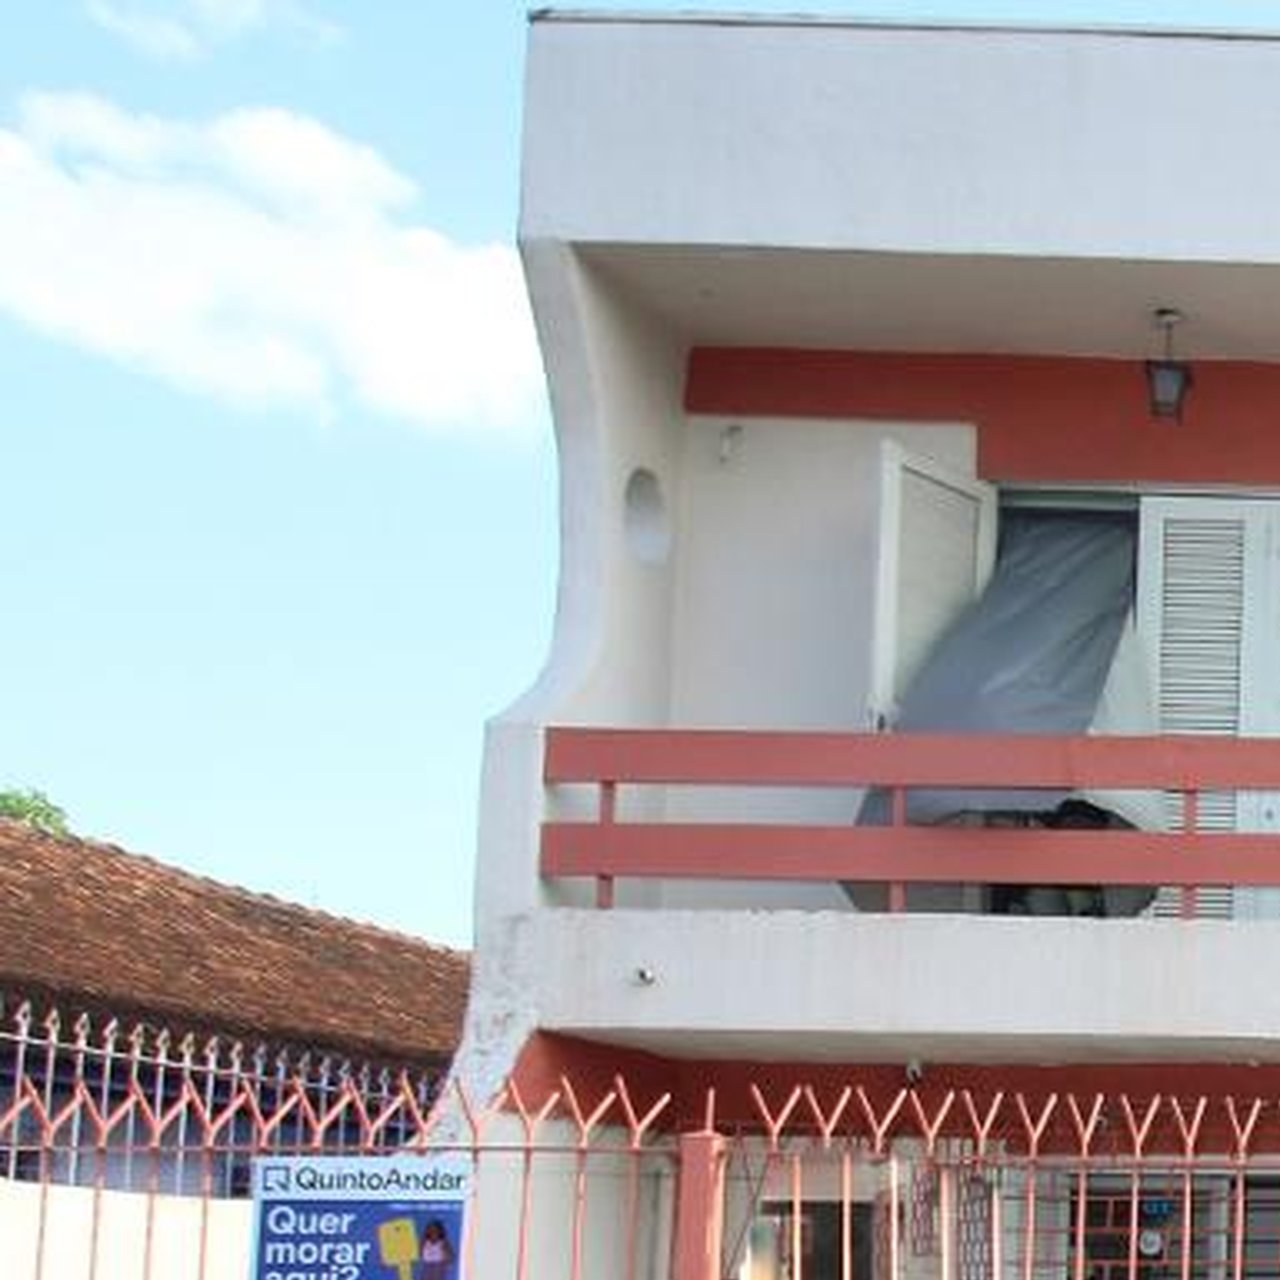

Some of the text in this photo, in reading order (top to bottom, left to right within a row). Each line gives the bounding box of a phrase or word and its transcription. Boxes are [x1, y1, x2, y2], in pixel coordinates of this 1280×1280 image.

[295, 1167, 465, 1190] QuintoAndar
[267, 1206, 355, 1235] Quer
[264, 1241, 369, 1264] morar
